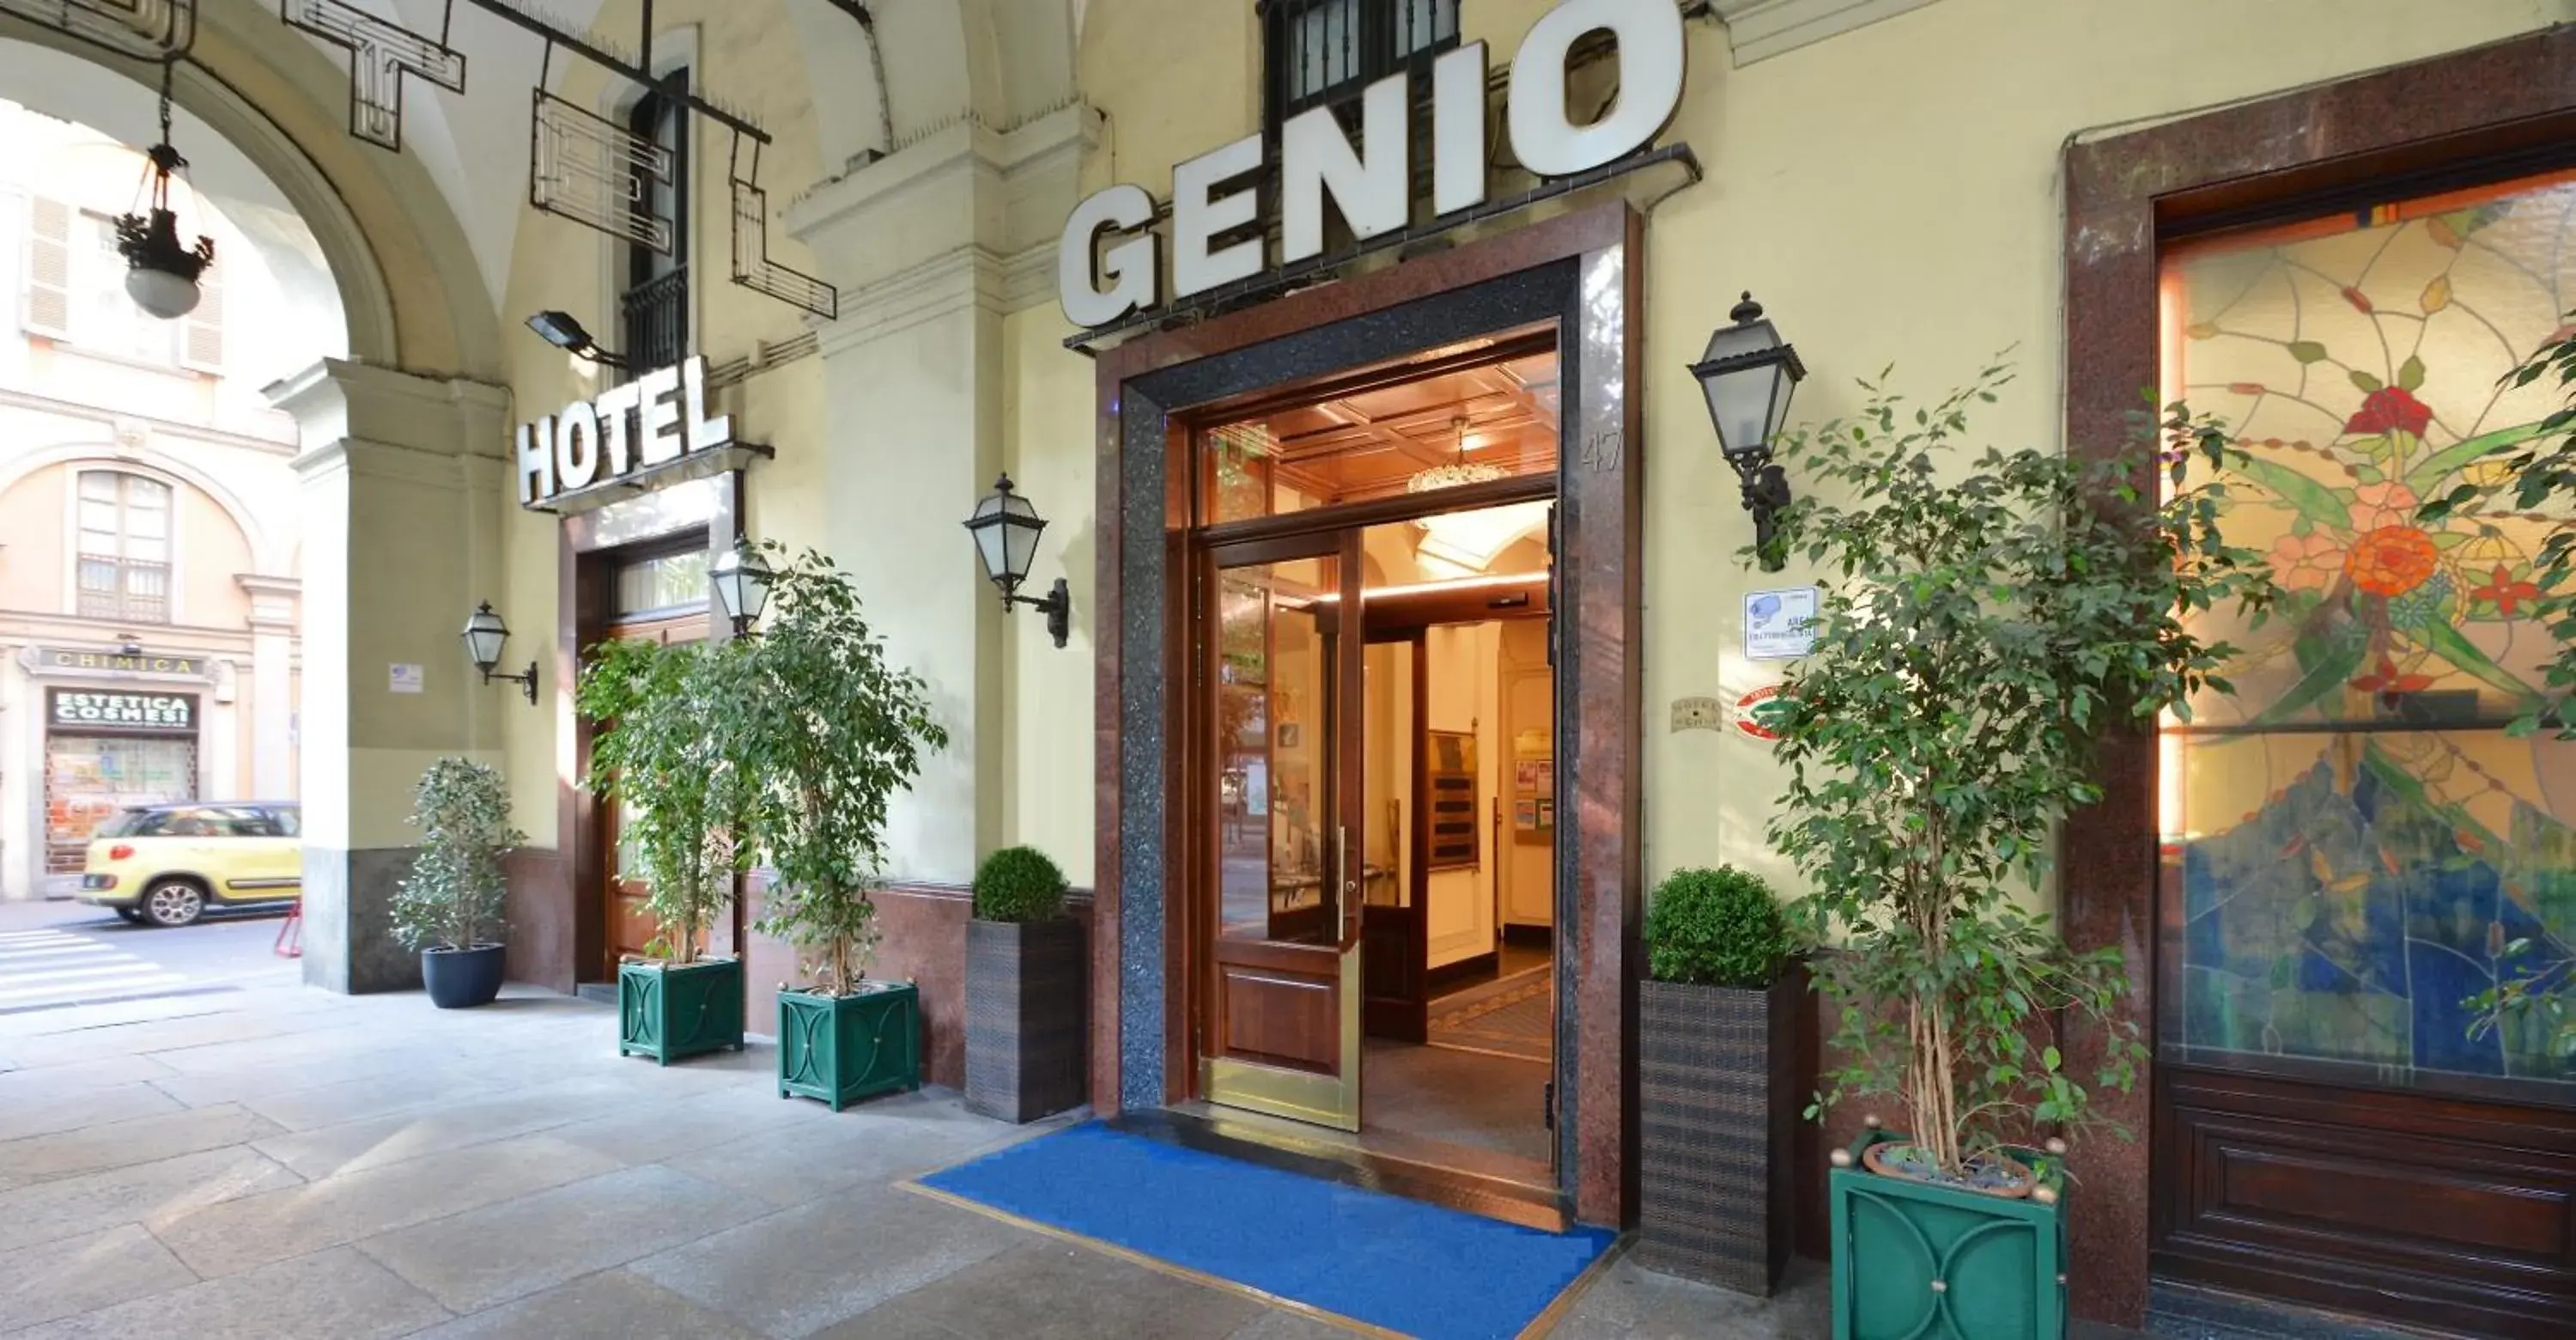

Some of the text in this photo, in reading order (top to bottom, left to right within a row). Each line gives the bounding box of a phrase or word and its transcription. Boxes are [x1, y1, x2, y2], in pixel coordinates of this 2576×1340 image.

[1059, 0, 1688, 328] GENIO
[517, 355, 732, 506] HOTEL
[1582, 429, 1623, 473] 47
[55, 652, 191, 673] CHIMICA
[56, 692, 189, 711] ESTETICA
[57, 705, 190, 723] COSMESI
